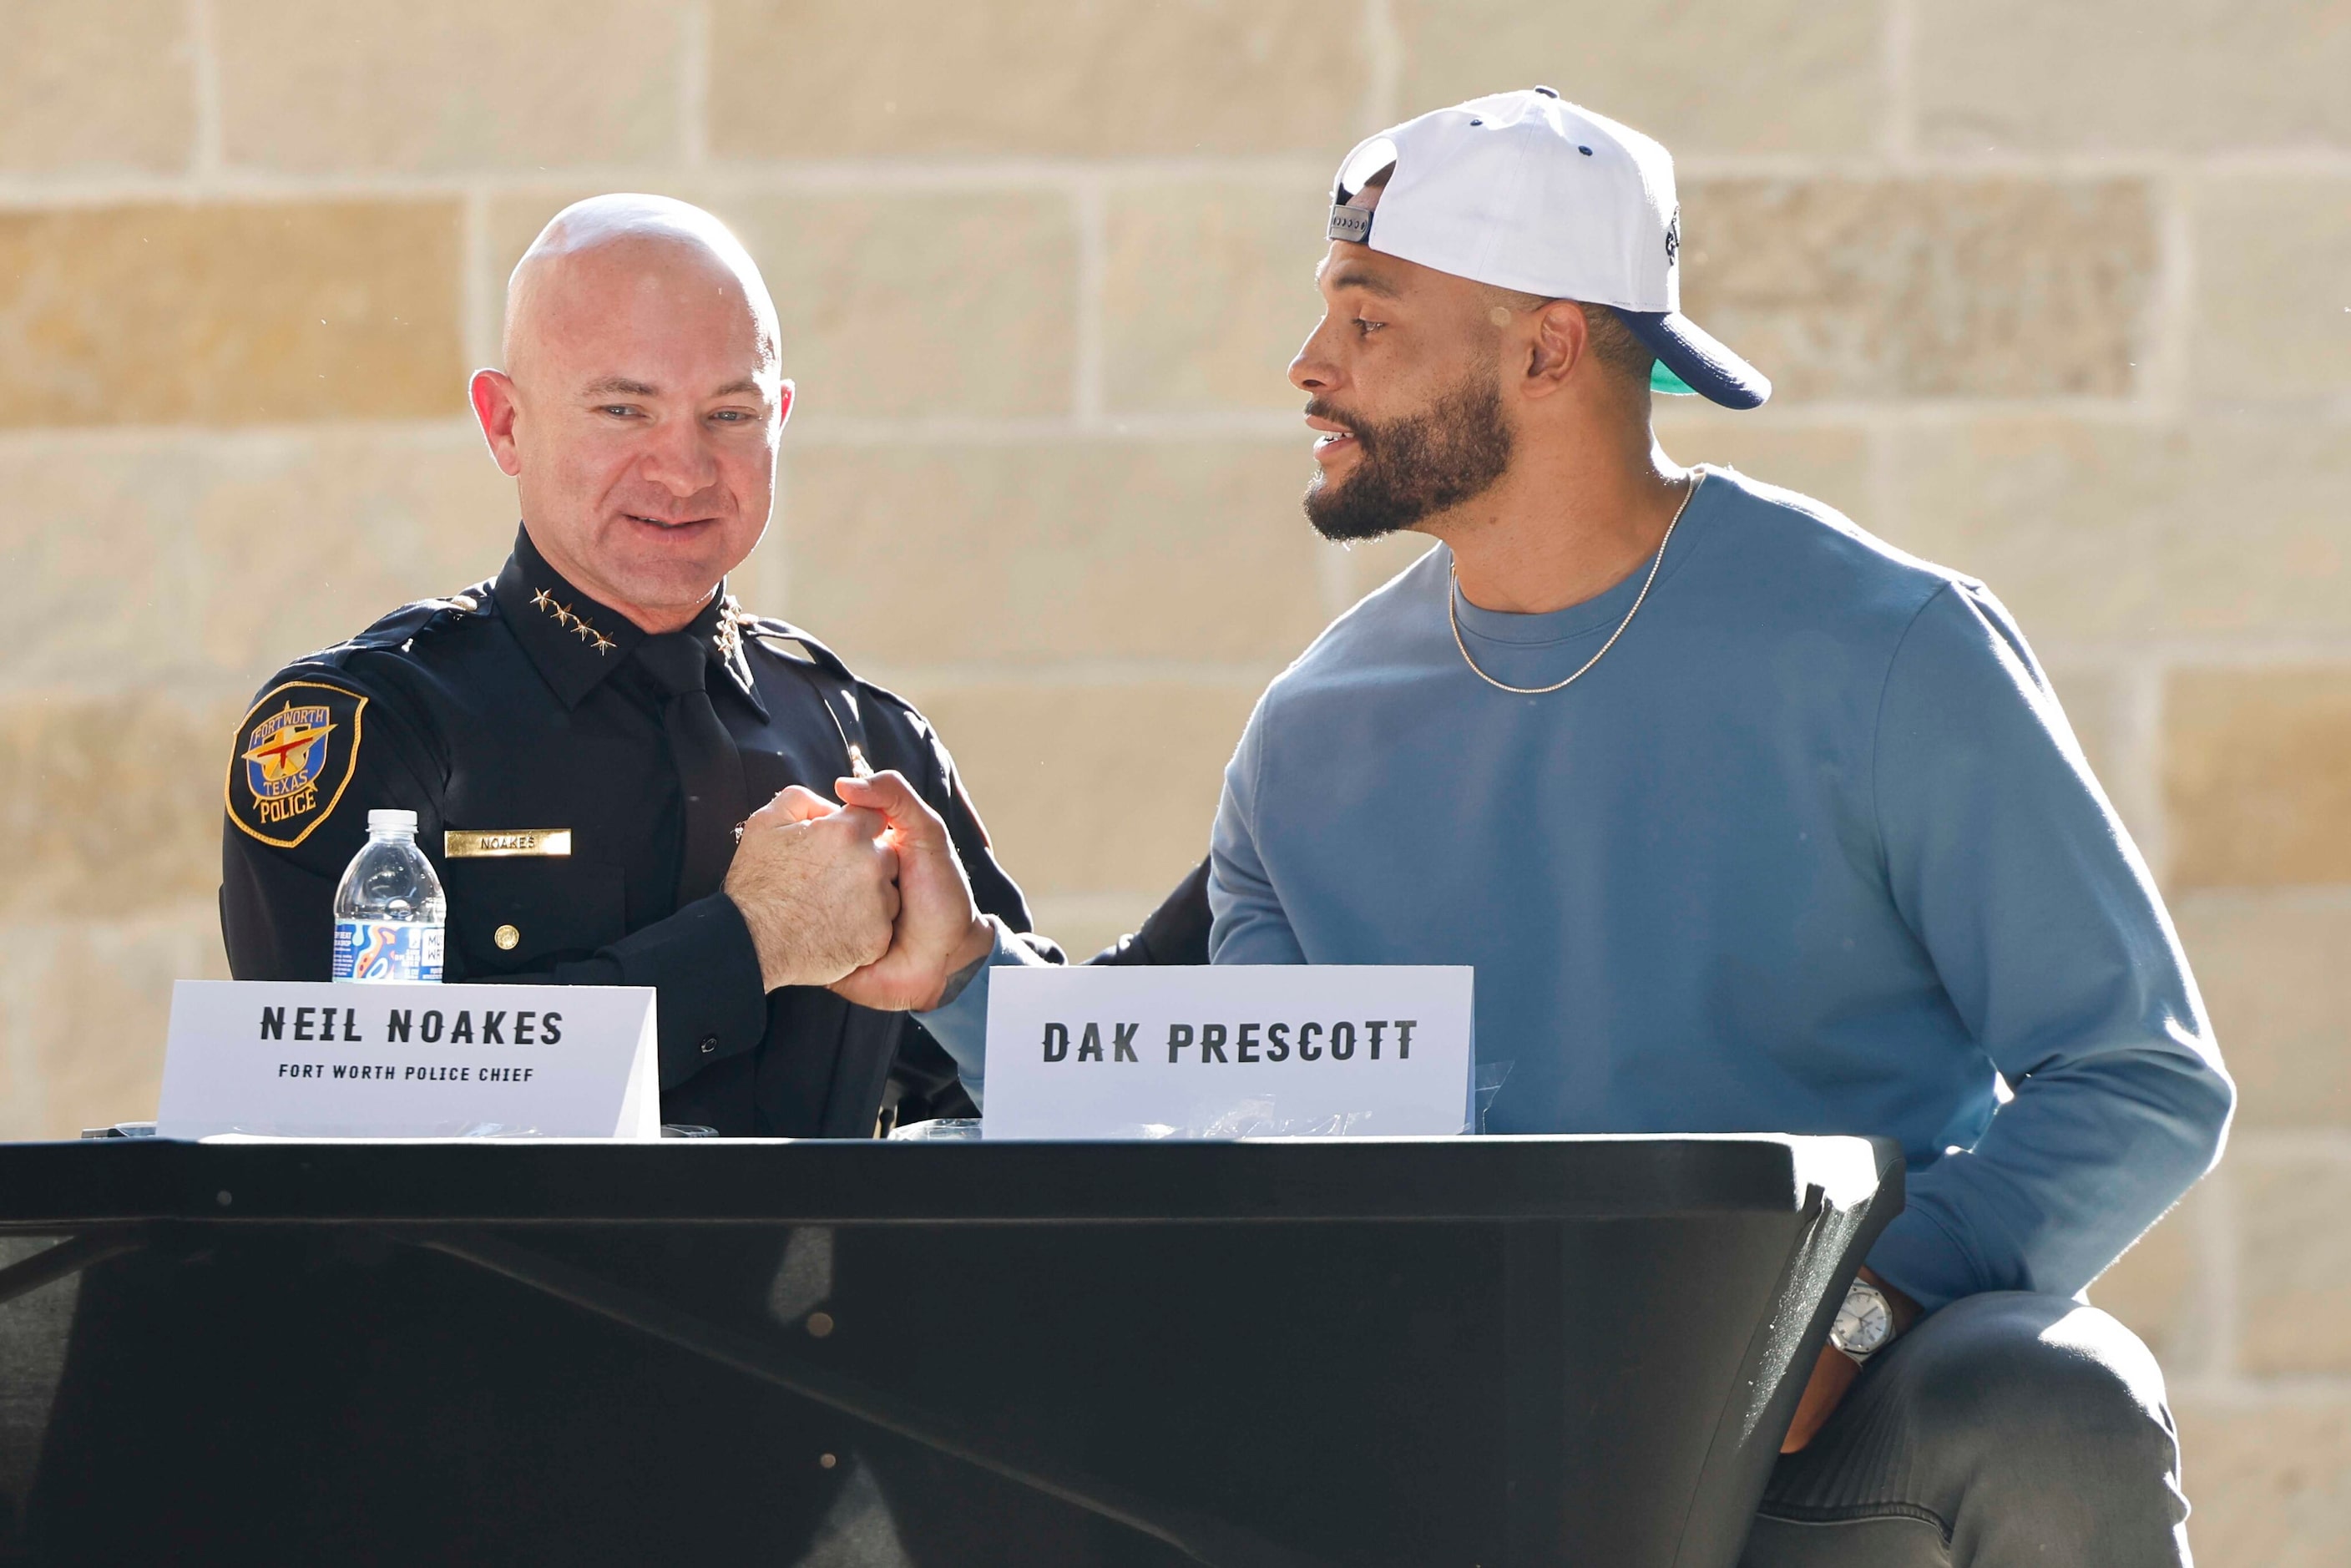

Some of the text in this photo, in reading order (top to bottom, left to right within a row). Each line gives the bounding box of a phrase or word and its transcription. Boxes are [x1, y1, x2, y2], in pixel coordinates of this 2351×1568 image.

[253, 709, 323, 745] FORT WORTH
[263, 770, 308, 796] TEXAS
[260, 791, 316, 823] POLICE
[481, 837, 535, 849] NOAKES
[260, 1007, 562, 1044] NEIL NOAKES
[1042, 1020, 1417, 1063] DAK PRESCOTT
[279, 1065, 533, 1081] FORT WORTH POLICE CHIEF
